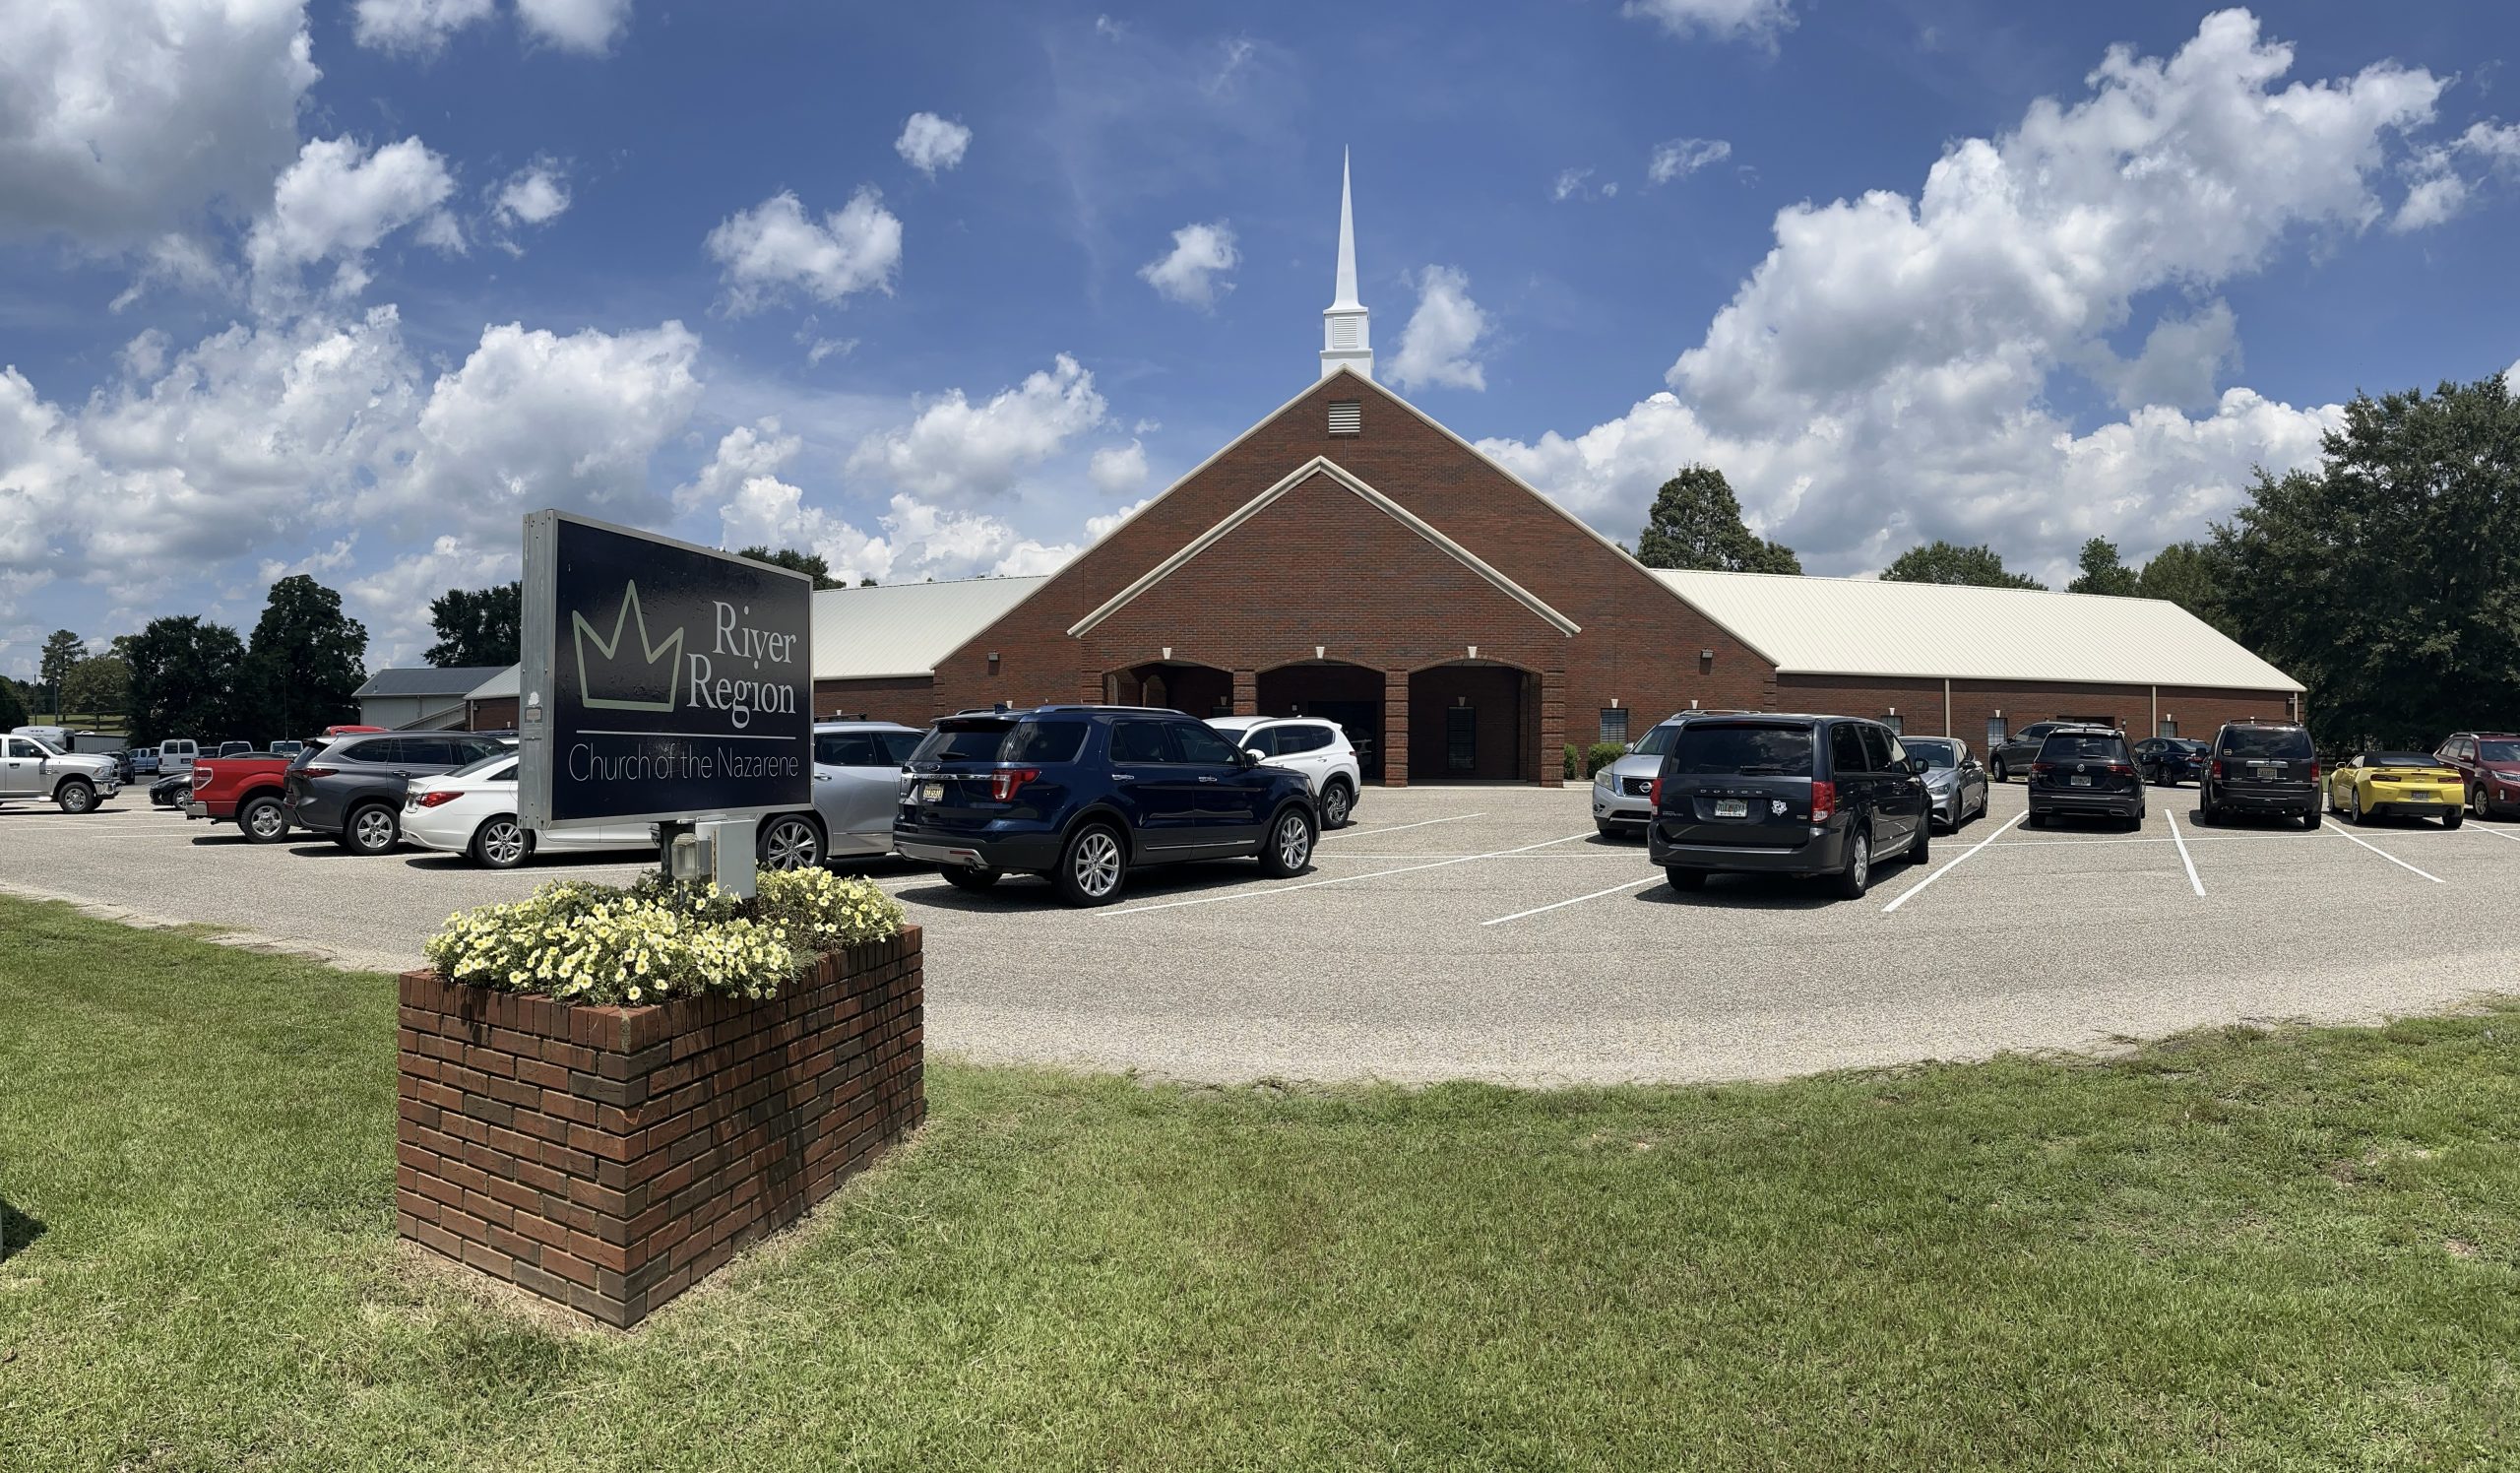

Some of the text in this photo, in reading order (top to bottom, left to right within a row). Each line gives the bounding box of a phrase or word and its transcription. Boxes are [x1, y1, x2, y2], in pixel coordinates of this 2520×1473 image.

[712, 600, 797, 664] River
[686, 653, 796, 729] Region
[568, 742, 799, 781] Church of the Nazarene
